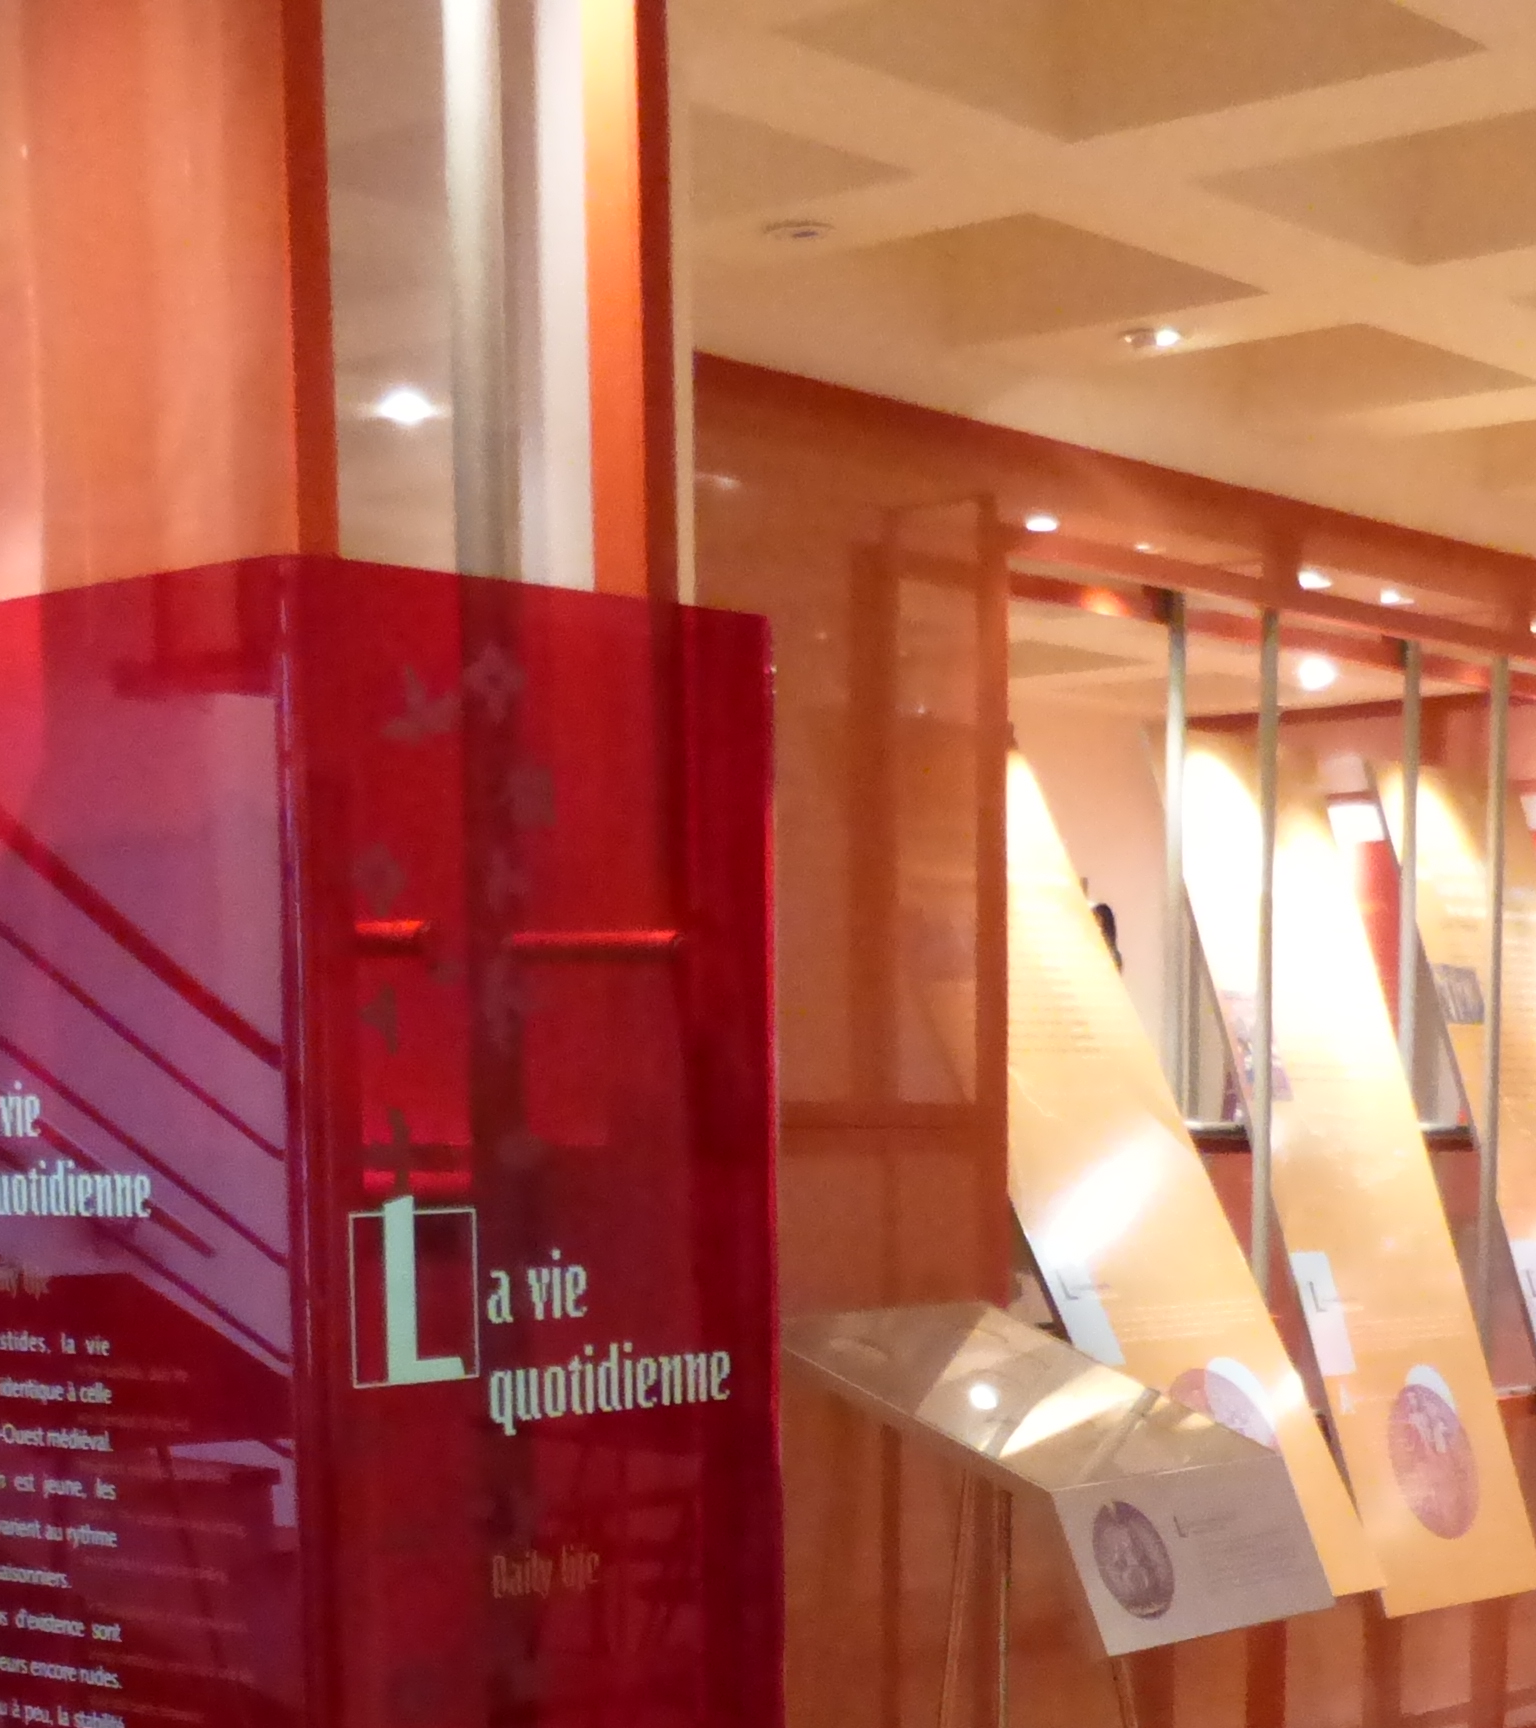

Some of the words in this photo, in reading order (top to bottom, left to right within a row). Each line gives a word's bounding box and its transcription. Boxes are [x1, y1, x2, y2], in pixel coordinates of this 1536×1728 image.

[0, 1081, 40, 1138] vie
[383, 1195, 513, 1384] La
[528, 1248, 588, 1320] vie
[61, 1332, 76, 1354] la
[84, 1334, 111, 1356] vie
[79, 1381, 112, 1404] celle
[488, 1342, 732, 1437] quotidienne
[13, 1473, 35, 1493] est
[94, 1477, 116, 1500] les
[91, 1619, 122, 1642] sont
